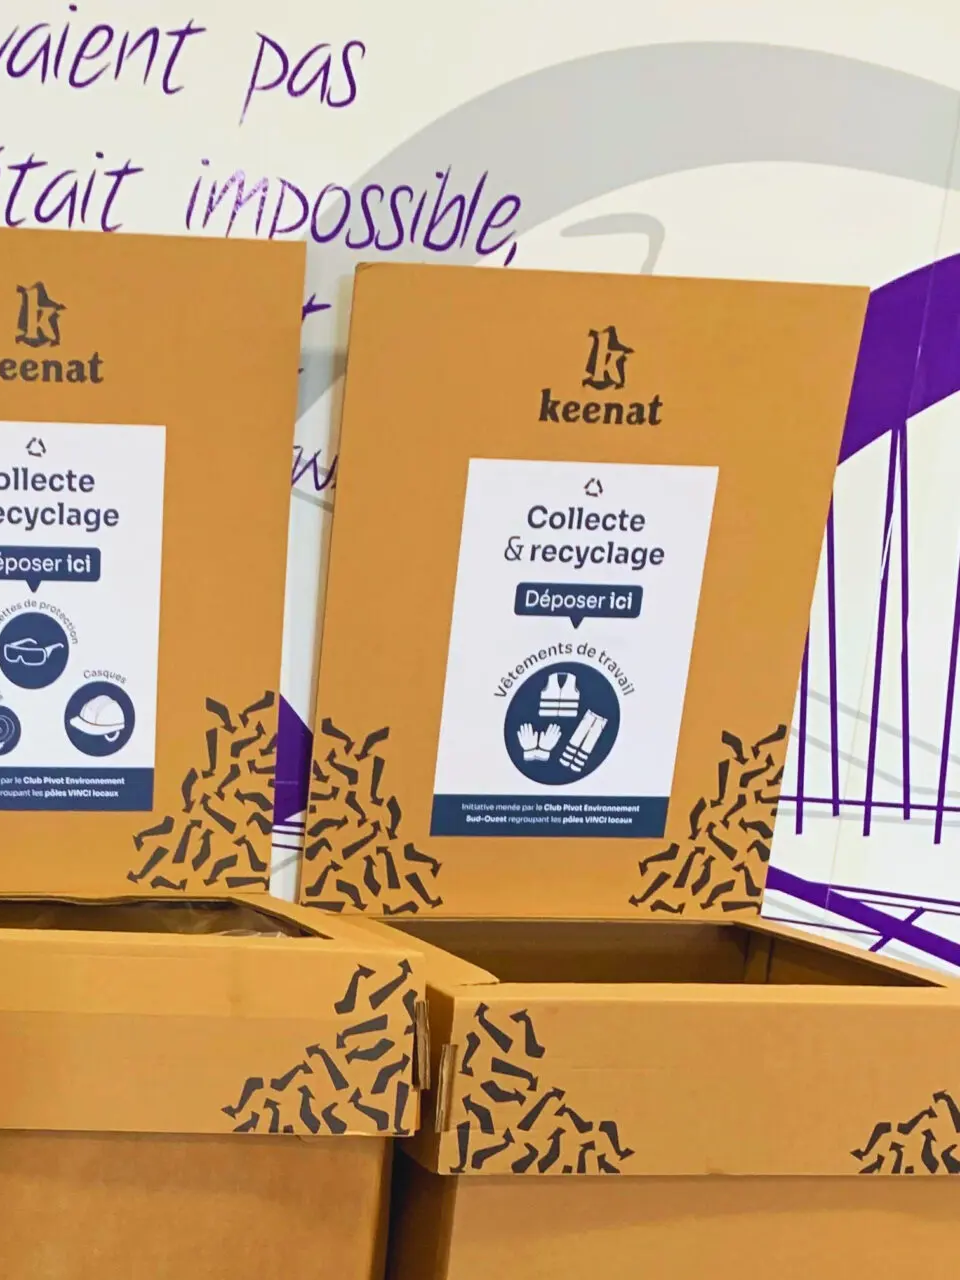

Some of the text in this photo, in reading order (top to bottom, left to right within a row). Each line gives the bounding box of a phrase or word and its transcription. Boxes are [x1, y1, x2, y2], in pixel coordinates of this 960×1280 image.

[240, 32, 365, 126] pas
[186, 158, 521, 266] impossible,
[539, 388, 663, 426] keenat
[527, 505, 646, 532] Collecte
[66, 554, 91, 572] ici
[504, 536, 665, 571] & recyclage
[525, 589, 632, 612] Déposer ici
[24, 599, 36, 608] de
[39, 601, 78, 645] protection
[83, 669, 127, 685] Casques
[494, 641, 635, 700] Vêtements de travail
[0, 778, 13, 787] par
[14, 776, 22, 785] le
[23, 776, 42, 784] Club
[44, 777, 64, 785] Pivot
[66, 777, 125, 785] Environnement
[32, 789, 43, 797] les
[45, 788, 66, 798] pôles
[67, 789, 91, 797] VINCI
[92, 789, 119, 797] locaux
[462, 803, 640, 813] Initiative menée par le Club Pivot Environnement
[466, 815, 507, 823] Sud-Ouest
[508, 816, 550, 825] regroupant
[551, 815, 561, 823] les
[563, 815, 584, 825] pôles
[608, 816, 633, 824] locaux
